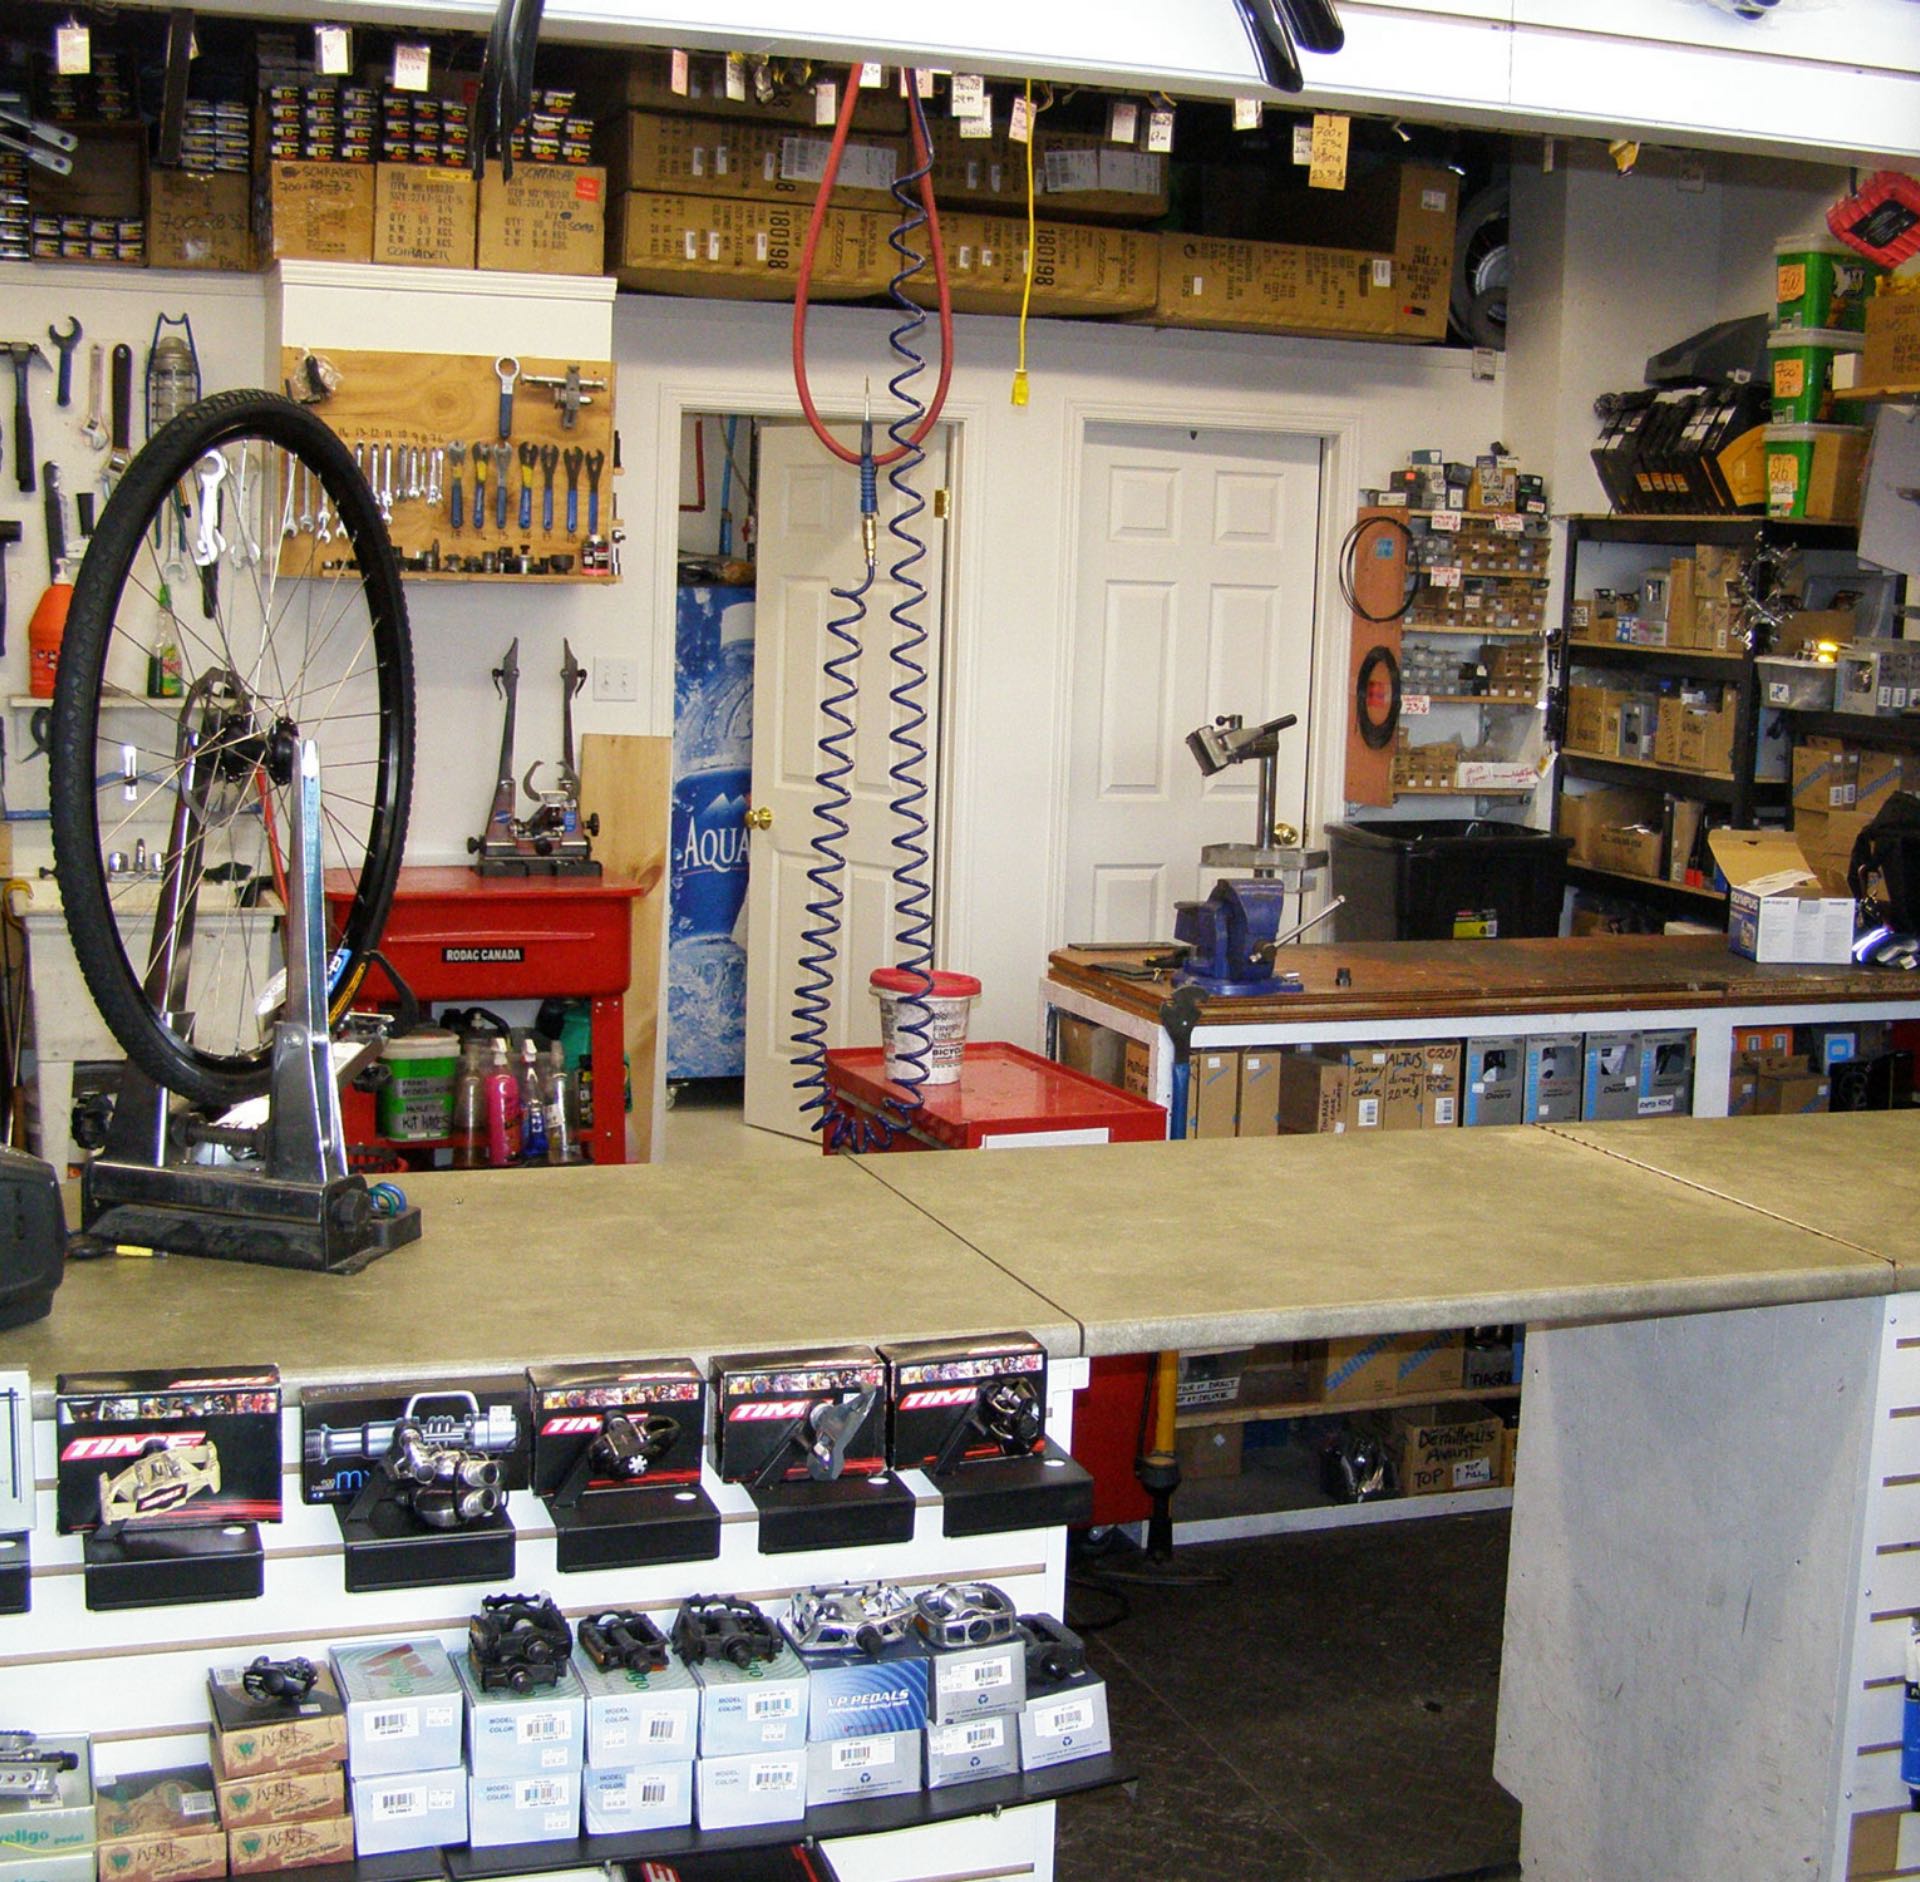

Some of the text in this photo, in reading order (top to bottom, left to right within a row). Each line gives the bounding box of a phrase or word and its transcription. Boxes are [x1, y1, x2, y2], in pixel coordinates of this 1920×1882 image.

[768, 208, 791, 270] 180198
[1034, 227, 1056, 287] 180198
[680, 815, 749, 873] AQUA
[446, 949, 521, 962] RODAC CANADA
[1386, 1051, 1424, 1068] ALTUS
[1413, 1468, 1444, 1489] TOP
[850, 1688, 910, 1706] PEDALS
